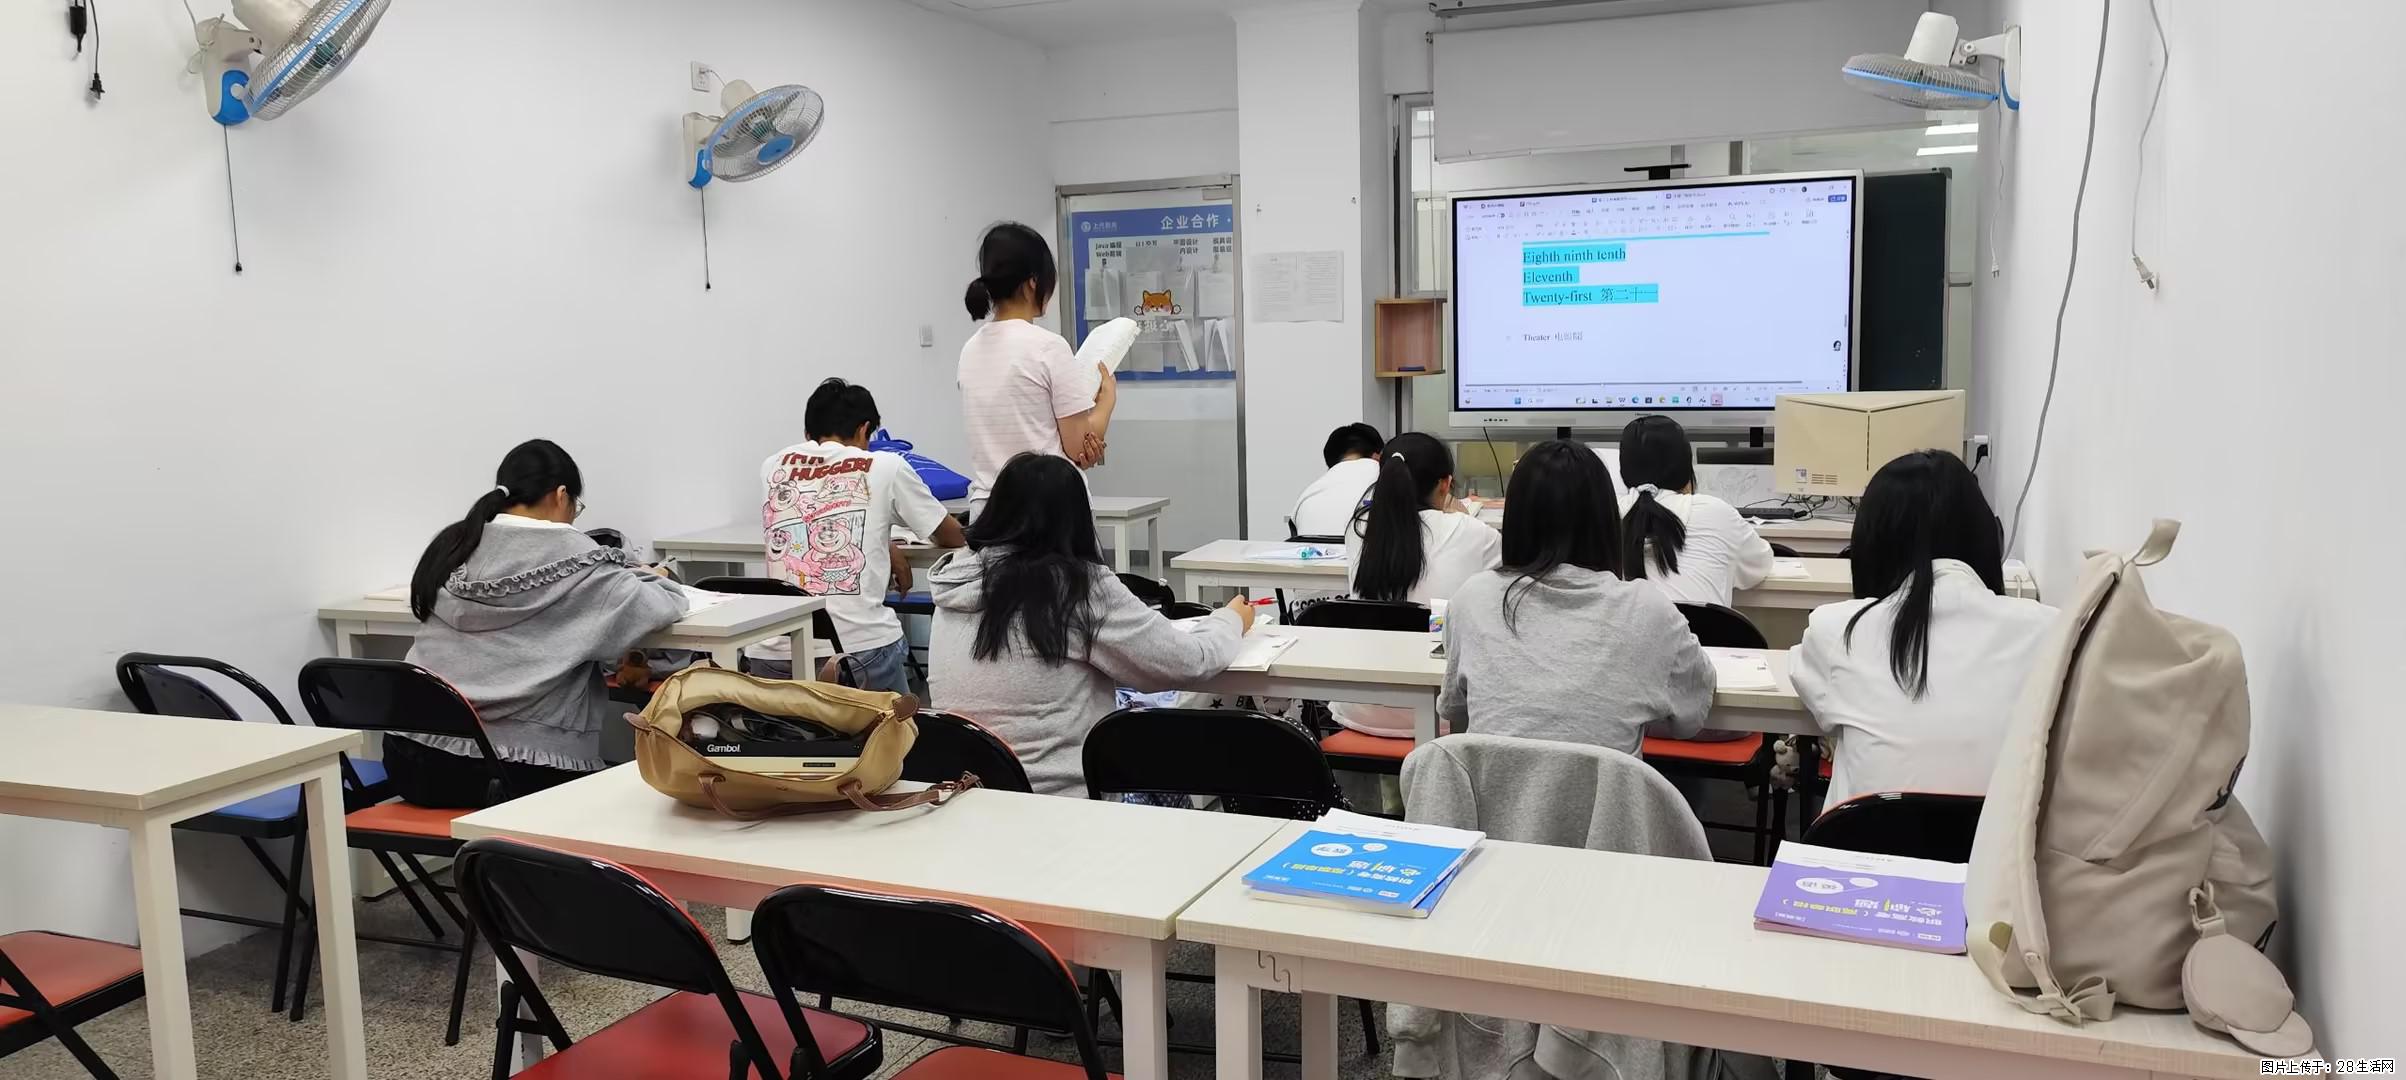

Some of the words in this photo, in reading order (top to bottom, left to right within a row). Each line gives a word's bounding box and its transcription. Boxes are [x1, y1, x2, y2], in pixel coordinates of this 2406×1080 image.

[1160, 213, 1219, 230] 企业合作
[1523, 251, 1560, 265] Eighth
[1564, 249, 1593, 261] ninth
[1597, 247, 1626, 261] tenth
[1523, 270, 1573, 284] Eleventh
[1523, 290, 1593, 305] Twenty-first
[1523, 333, 1550, 342] Theater
